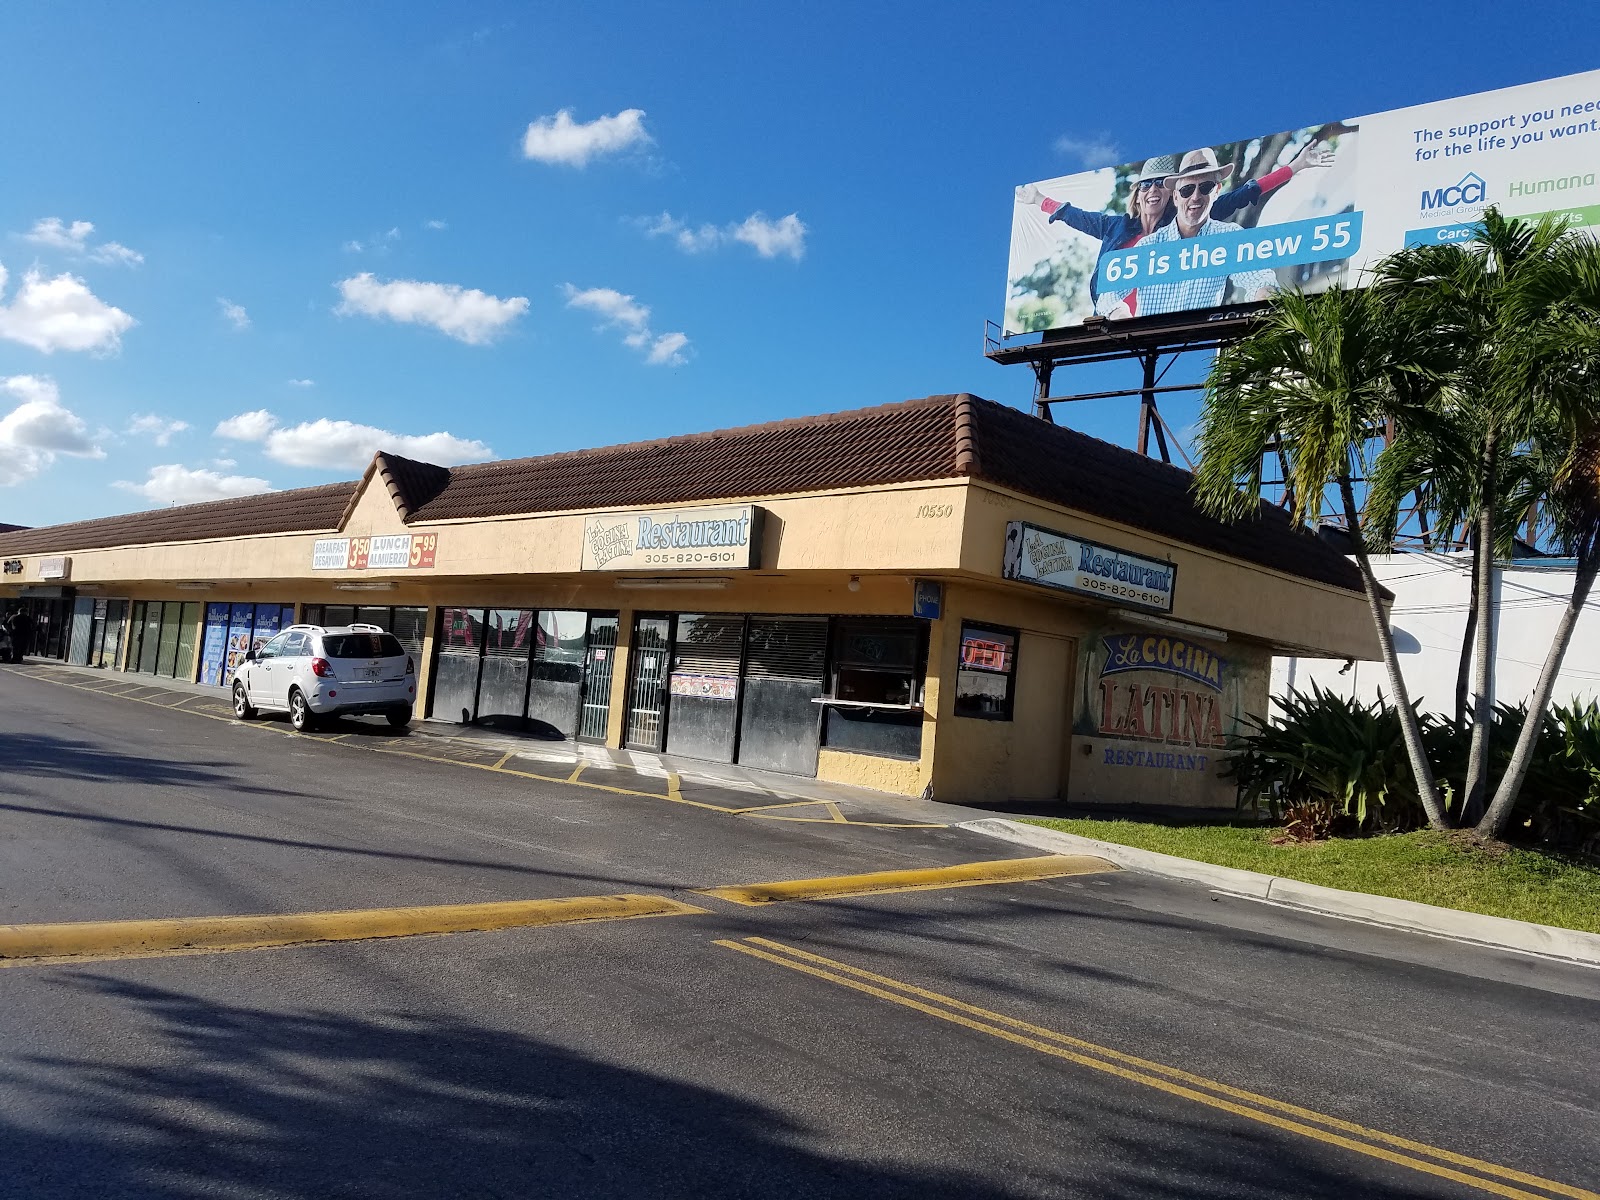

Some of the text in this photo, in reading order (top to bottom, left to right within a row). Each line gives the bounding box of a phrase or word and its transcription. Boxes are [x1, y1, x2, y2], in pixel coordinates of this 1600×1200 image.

[1413, 128, 1443, 144] The
[1448, 114, 1516, 138] support
[1519, 108, 1554, 129] you
[1415, 148, 1439, 161] for
[1444, 142, 1472, 157] the
[1477, 136, 1506, 151] life
[1510, 130, 1544, 149] you
[1420, 180, 1486, 210] MCCI
[1509, 173, 1595, 197] Humana
[1419, 208, 1454, 219] Medical
[1521, 211, 1584, 230] Beefits
[1105, 221, 1352, 282] 65 is the new 55
[915, 504, 953, 518] 10550
[587, 519, 604, 543] LA
[636, 510, 750, 551] Restaurant
[315, 541, 348, 554] BREAKFAST
[373, 537, 410, 551] LUNCH
[595, 540, 633, 569] LATINA
[1025, 532, 1044, 555] LA
[314, 554, 345, 567] DESAYUNO
[369, 552, 408, 565] ALMUERZO
[645, 552, 736, 564] 305-820-6101
[1035, 555, 1075, 580] LATINA
[1078, 543, 1172, 593] Restaurant
[919, 594, 939, 604] PHONE
[1082, 577, 1165, 606] 305-820-6101
[963, 639, 1004, 670] OPEN
[1115, 635, 1219, 684] La COCINA
[1099, 679, 1226, 747] LATINA
[1103, 748, 1208, 772] RESTAURANT
